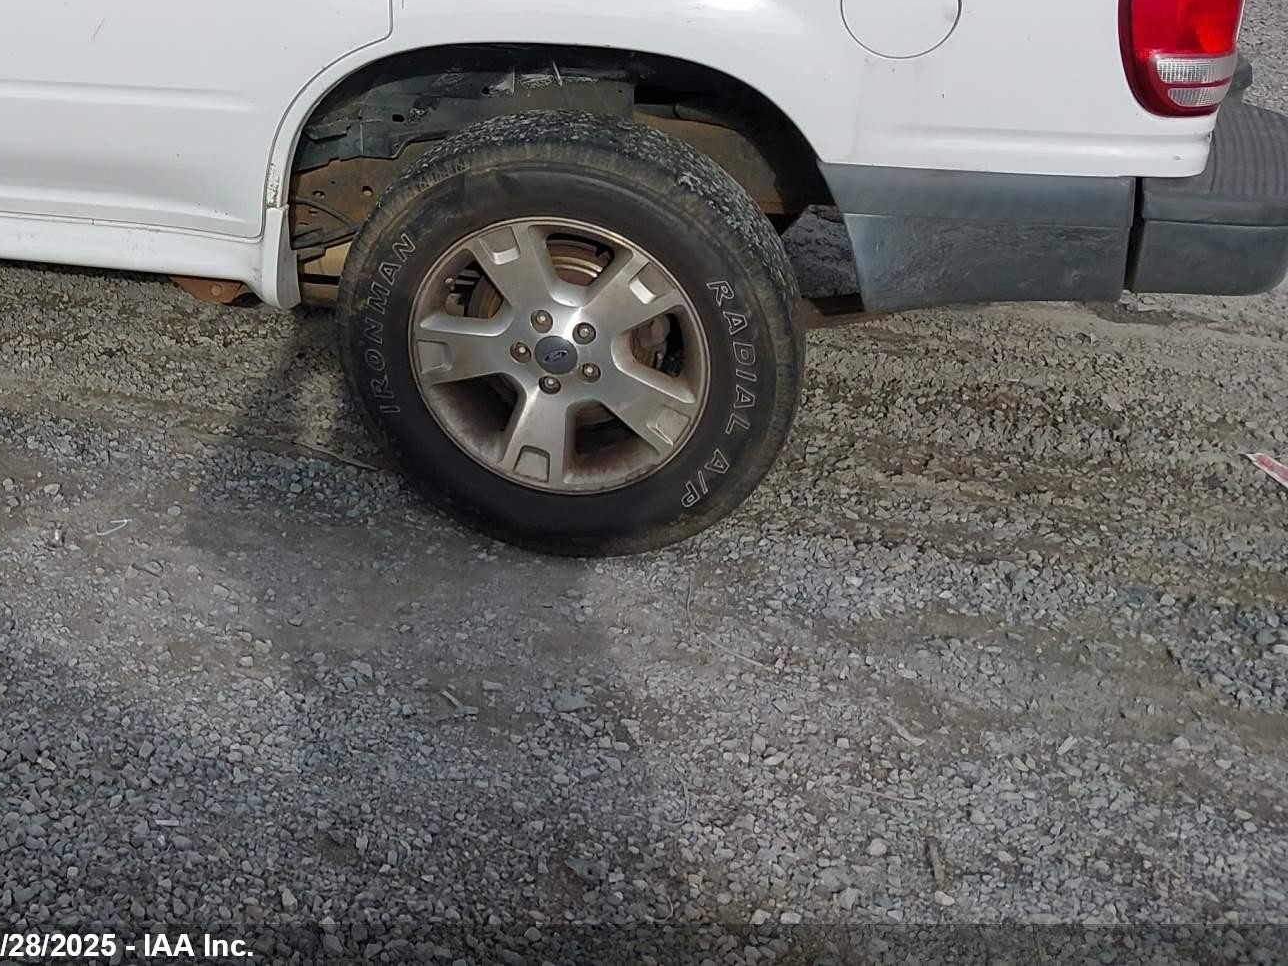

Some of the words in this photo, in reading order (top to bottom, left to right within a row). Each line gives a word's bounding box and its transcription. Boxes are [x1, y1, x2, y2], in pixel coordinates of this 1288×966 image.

[363, 233, 416, 416] IRONMAN
[706, 279, 758, 436] RADIAL
[681, 448, 731, 509] A/P
